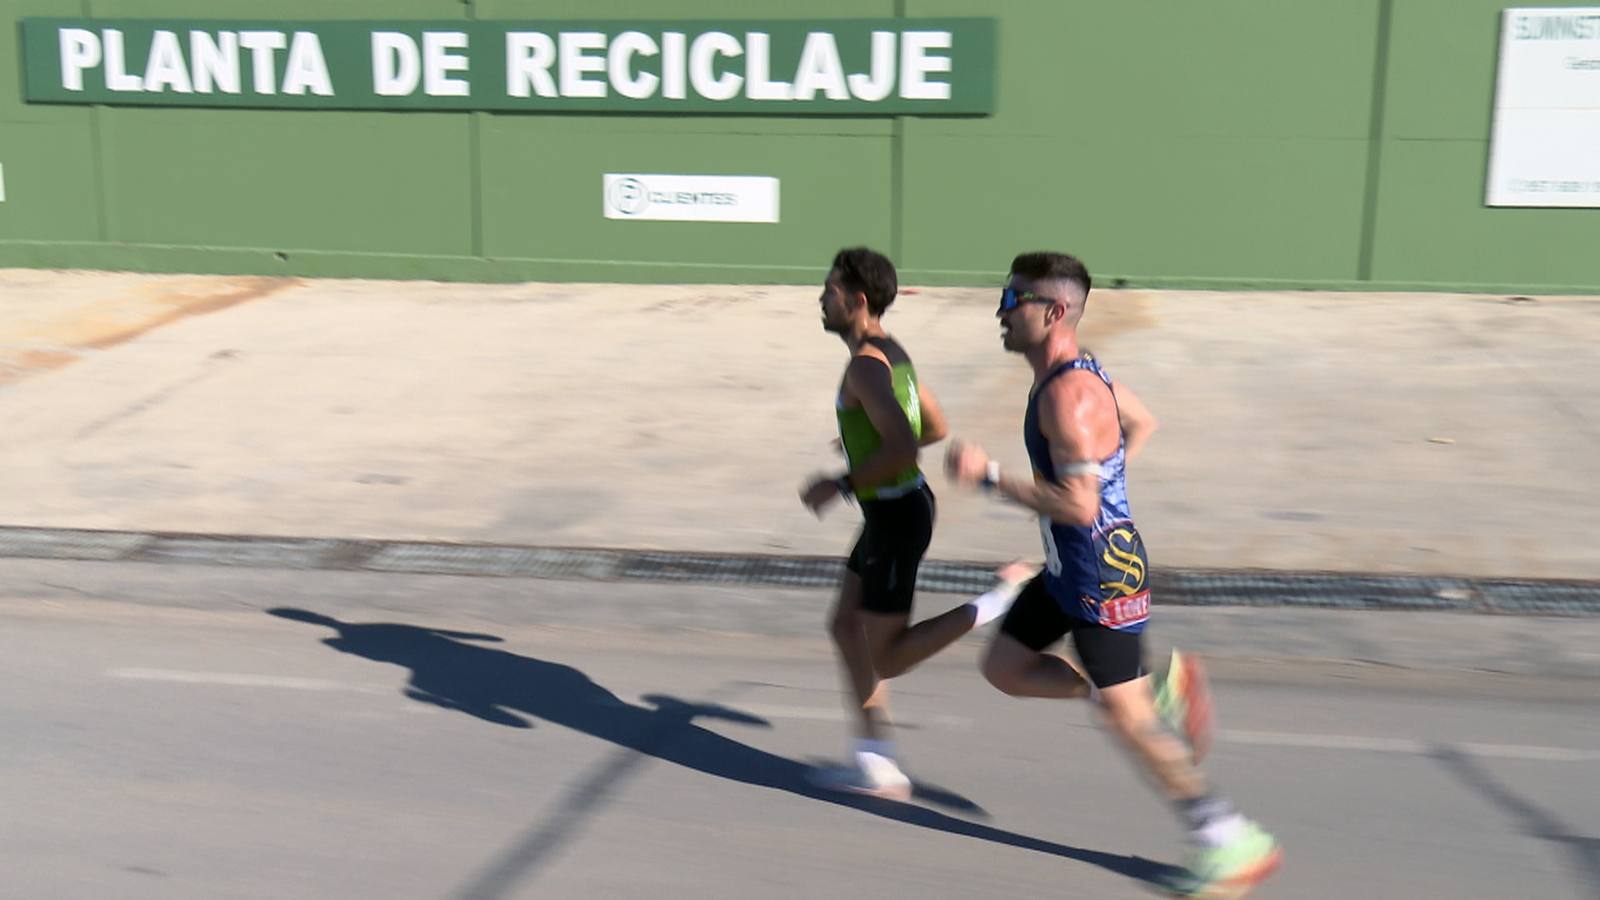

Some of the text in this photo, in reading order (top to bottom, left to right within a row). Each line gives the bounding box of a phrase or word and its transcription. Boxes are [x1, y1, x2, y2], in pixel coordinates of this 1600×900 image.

[58, 28, 953, 102] PLANTA DE RECICLAJE
[647, 190, 738, 206] CLIENTES
